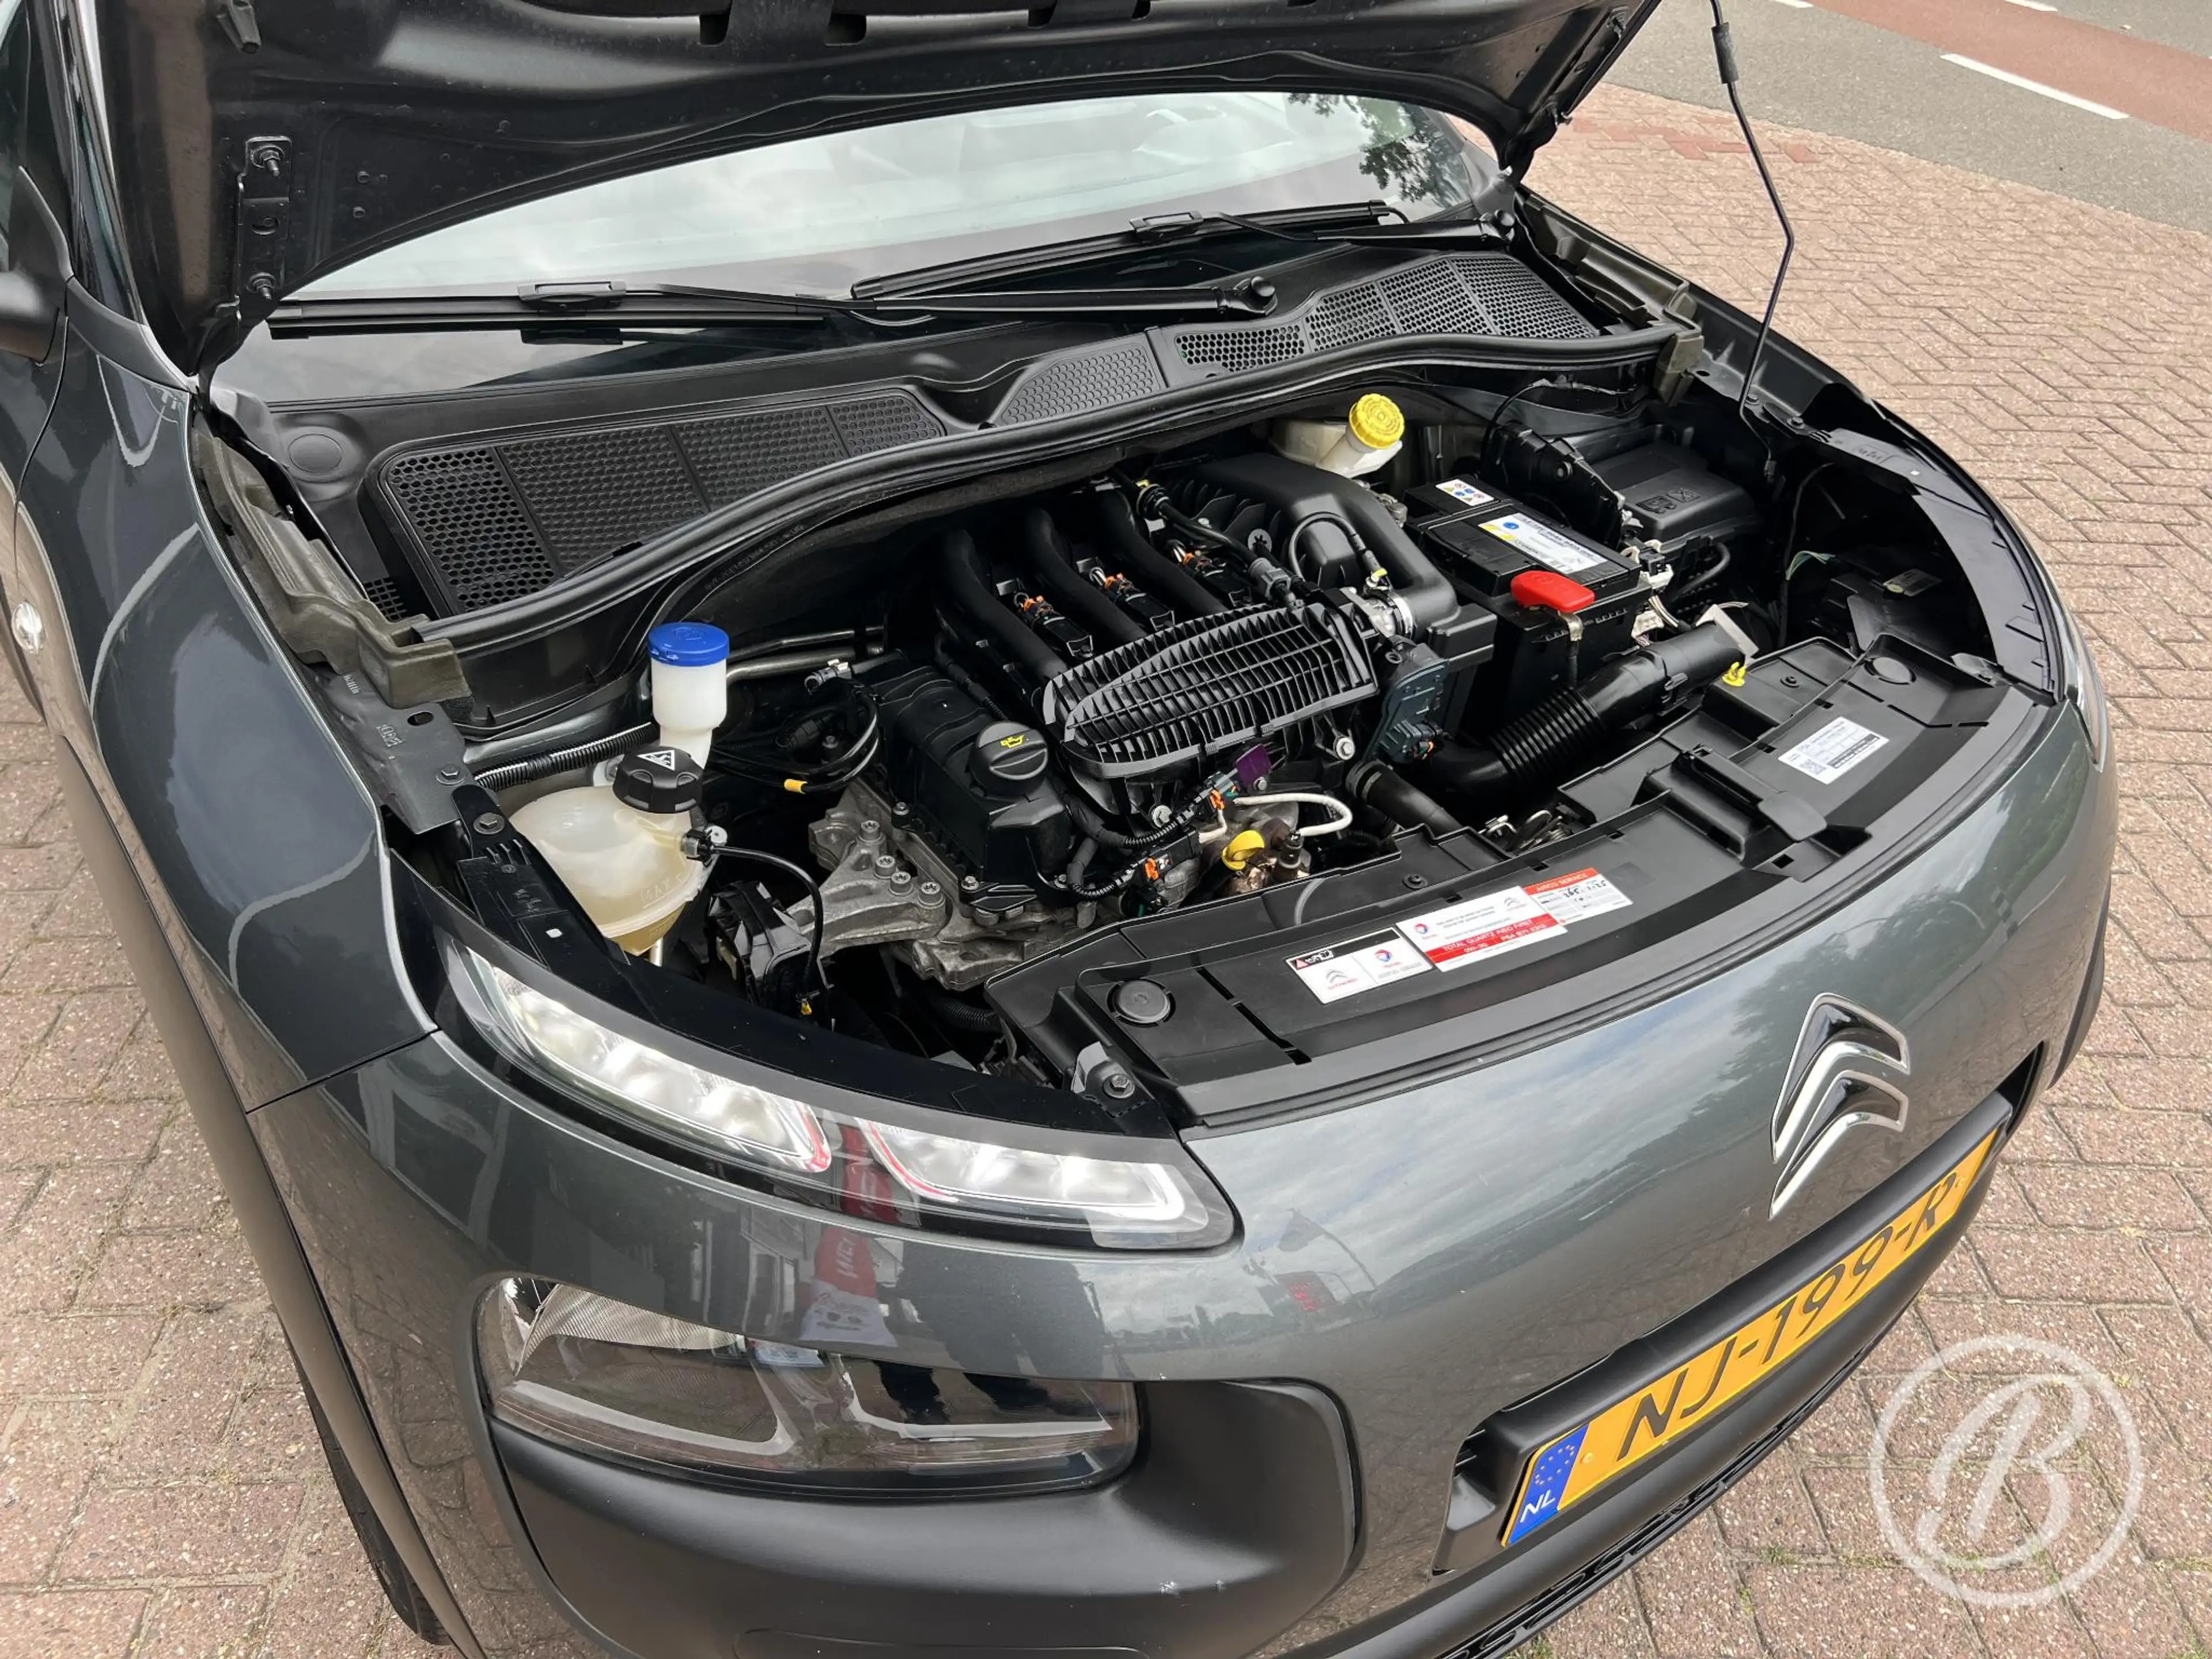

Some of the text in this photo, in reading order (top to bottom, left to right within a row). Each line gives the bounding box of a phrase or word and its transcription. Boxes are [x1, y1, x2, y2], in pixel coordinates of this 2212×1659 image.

[1557, 873, 1587, 884] SERVICE
[1441, 941, 1467, 951] TOTAL
[1464, 931, 1496, 944] QUARTZ
[1617, 1171, 1957, 1461] NJ-199-R
[1519, 1492, 1556, 1524] NL
